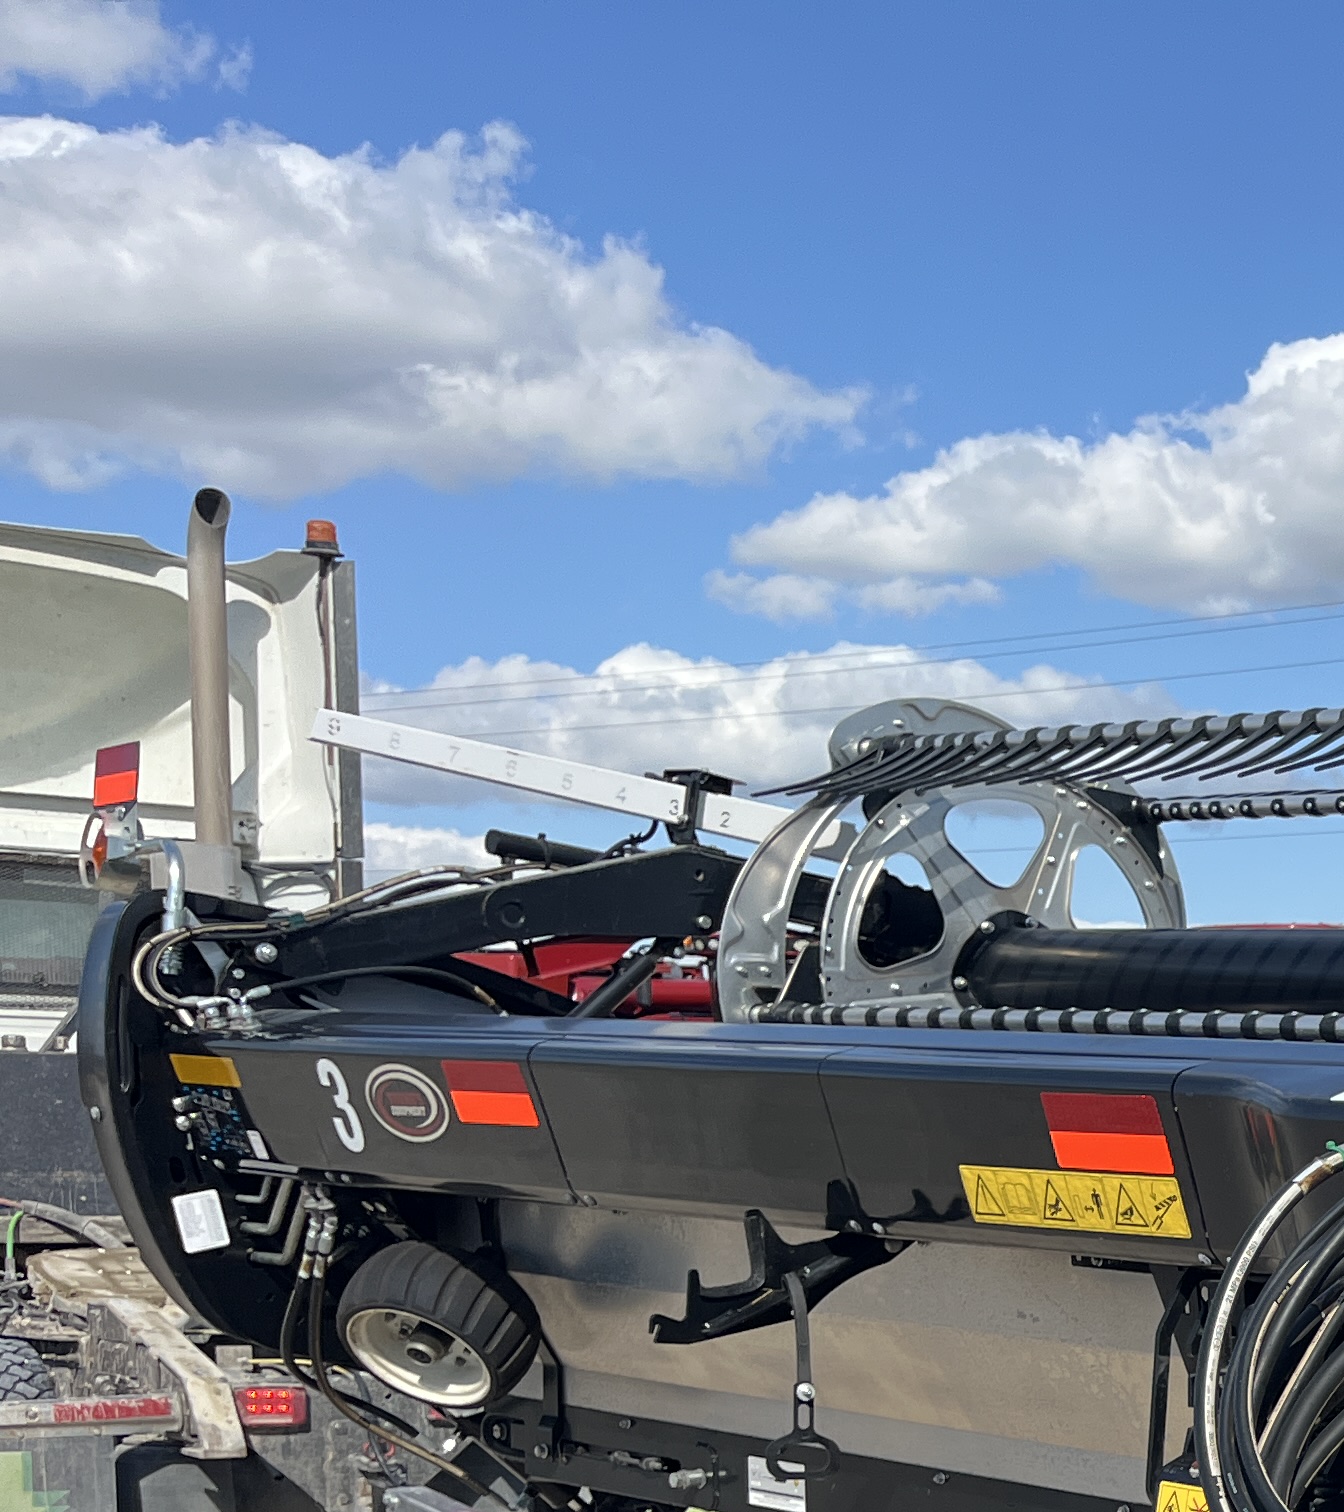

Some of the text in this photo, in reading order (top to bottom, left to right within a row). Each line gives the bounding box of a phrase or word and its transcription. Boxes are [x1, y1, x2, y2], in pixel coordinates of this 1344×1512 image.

[447, 744, 461, 764] 7
[615, 786, 627, 804] 4
[668, 798, 680, 816] 3
[719, 810, 731, 828] 2
[315, 1057, 366, 1154] 3
